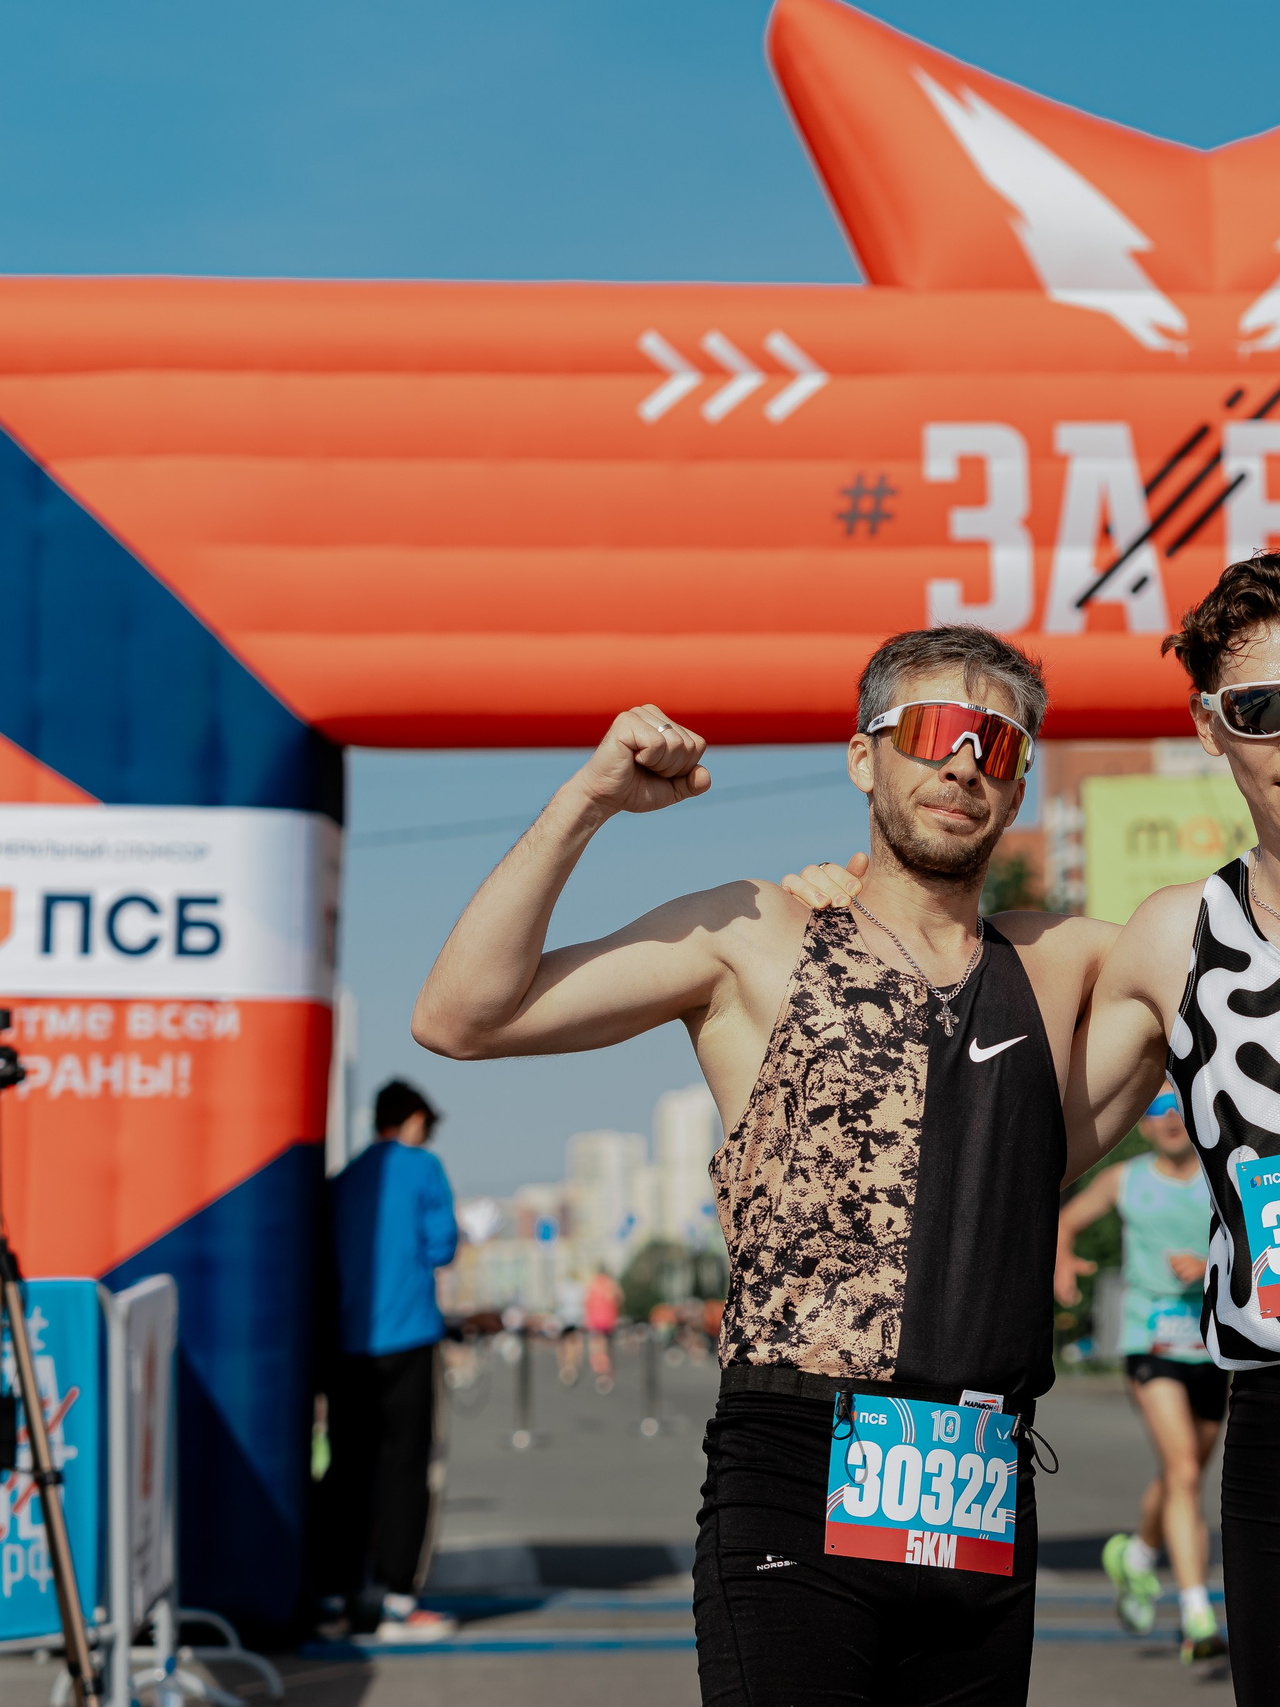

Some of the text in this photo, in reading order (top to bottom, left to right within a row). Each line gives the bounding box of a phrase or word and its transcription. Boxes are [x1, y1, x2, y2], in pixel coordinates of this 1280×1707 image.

[40, 893, 222, 957] ПСБ
[859, 1411, 888, 1426] ПСБ
[964, 1400, 994, 1411] МАРАФОН
[843, 1441, 1009, 1534] 30322
